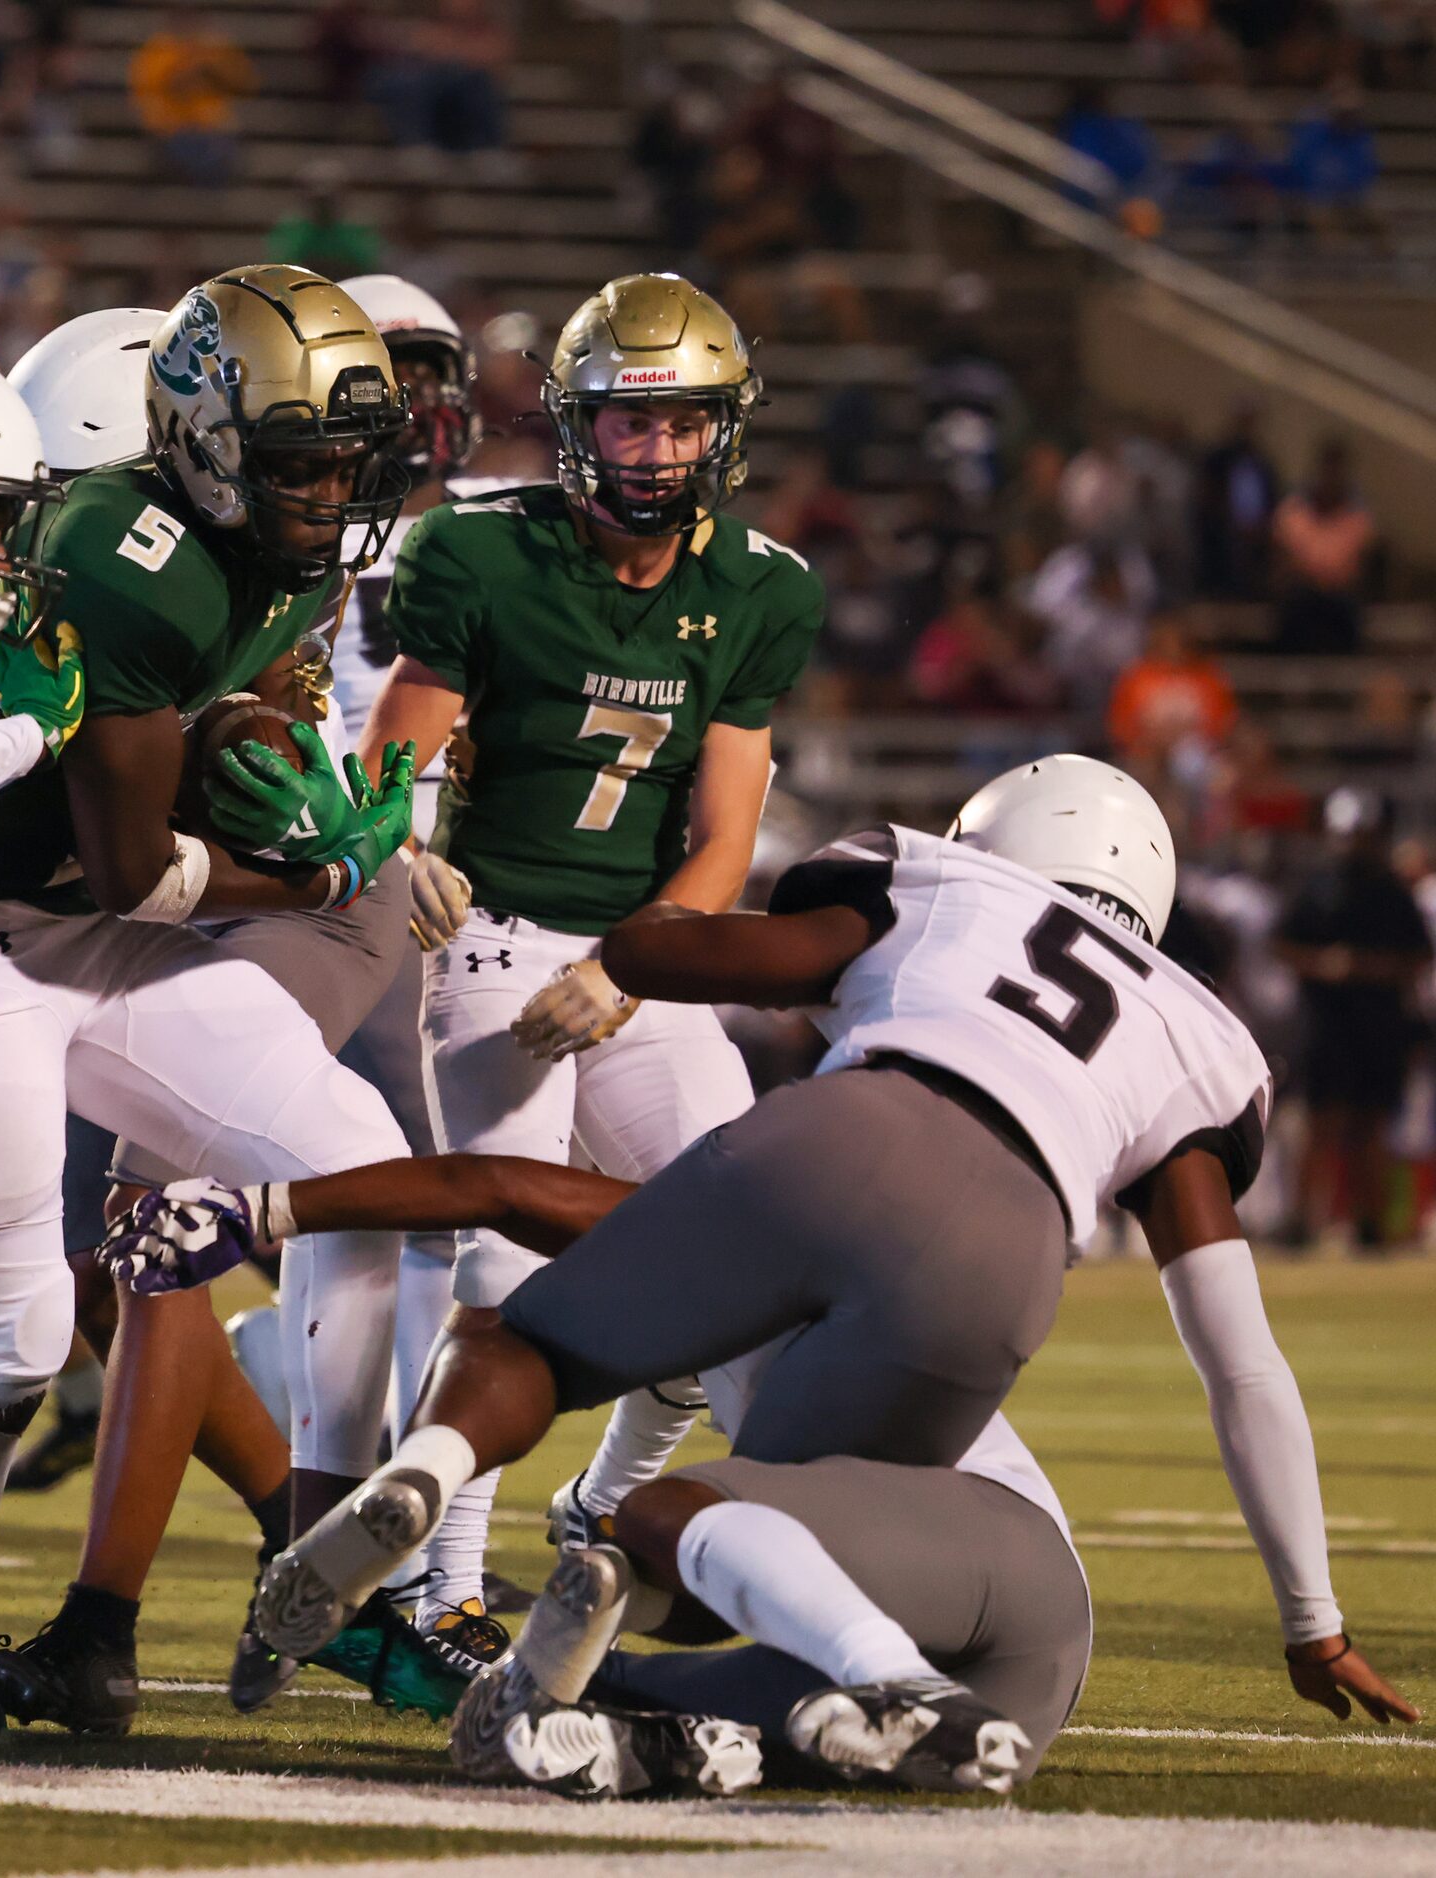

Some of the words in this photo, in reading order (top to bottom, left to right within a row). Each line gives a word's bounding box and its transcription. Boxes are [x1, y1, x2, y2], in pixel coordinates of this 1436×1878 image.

[116, 504, 187, 573] 5
[582, 671, 687, 706] BIRDVILLE
[574, 702, 672, 832] 7
[984, 900, 1154, 1065] 5
